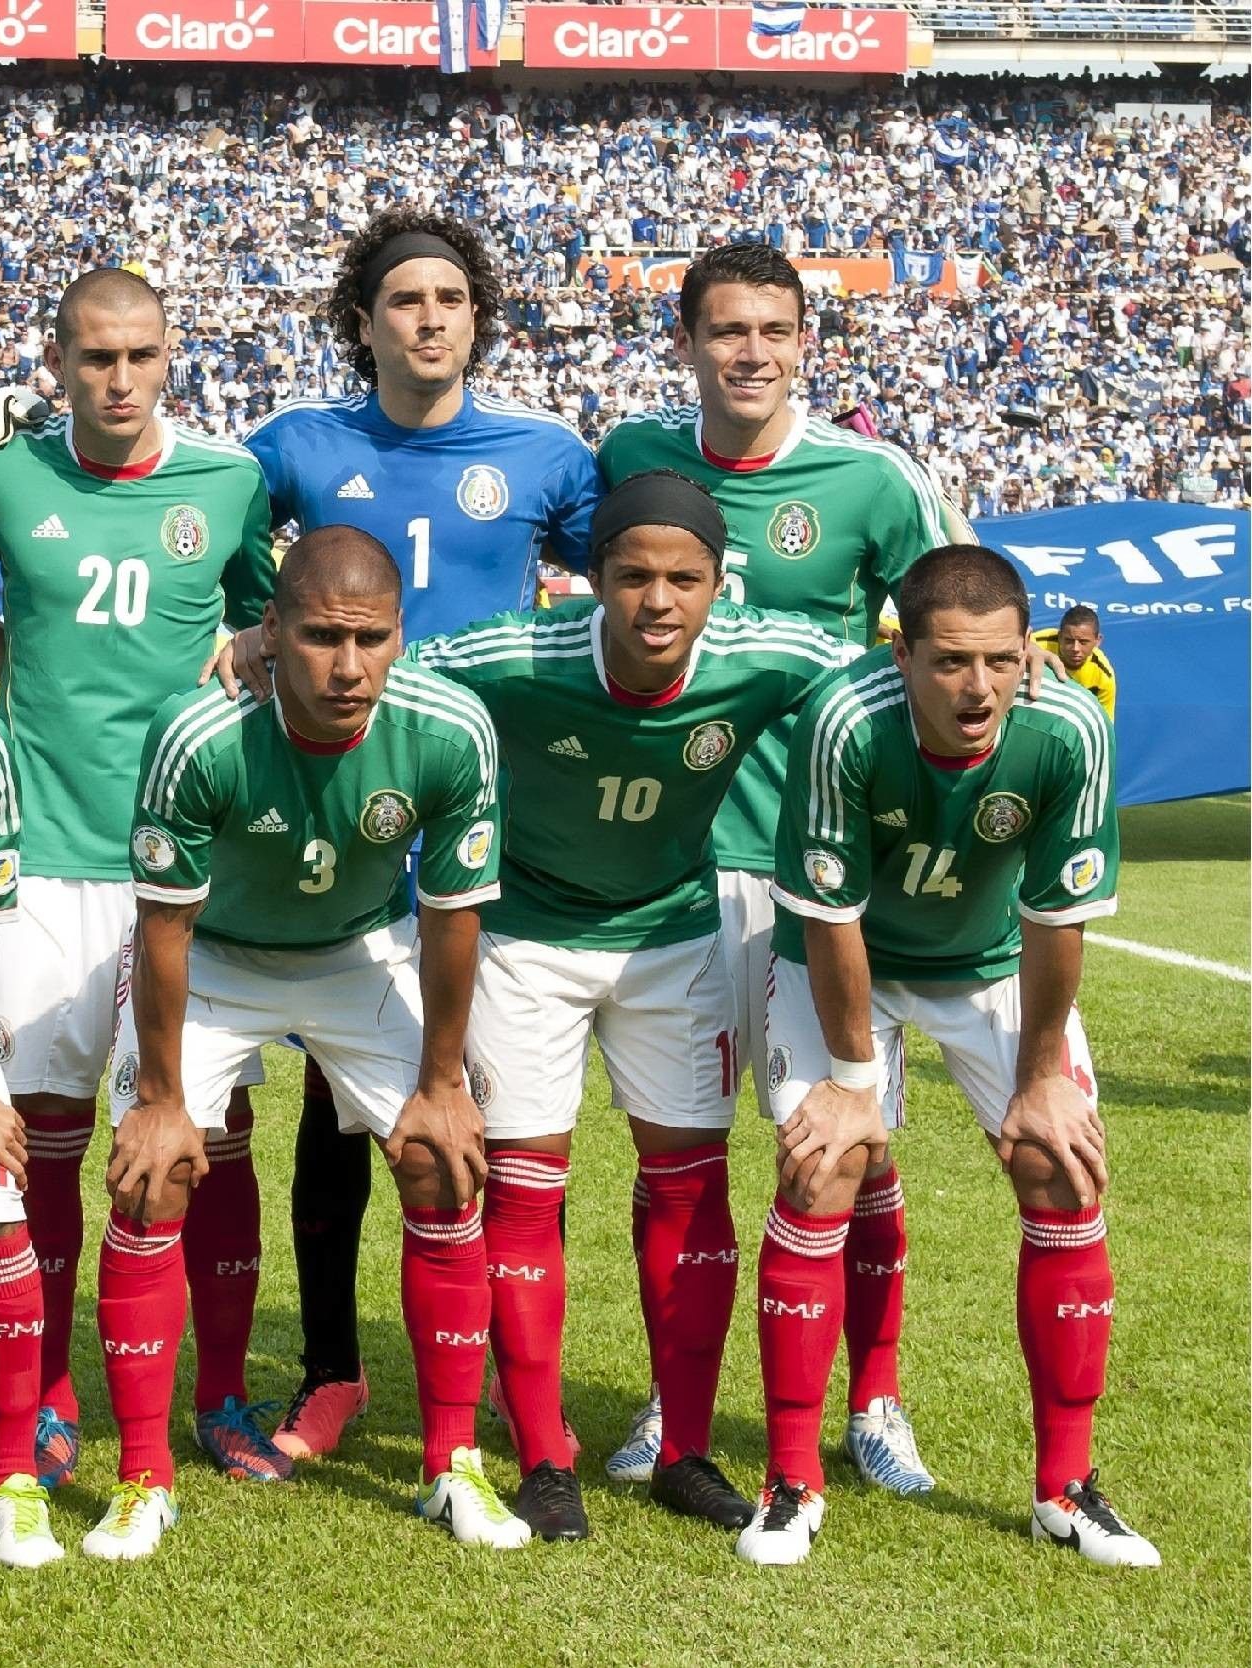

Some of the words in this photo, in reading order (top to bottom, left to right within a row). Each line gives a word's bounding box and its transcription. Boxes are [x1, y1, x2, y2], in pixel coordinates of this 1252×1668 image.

[136, 13, 253, 50] Claro
[554, 21, 667, 58] Claro
[407, 517, 431, 589] 1
[714, 549, 749, 605] 5
[76, 554, 150, 627] 20
[597, 775, 663, 823] 10
[247, 823, 290, 833] adidas
[298, 839, 337, 894] 3
[901, 843, 963, 899] 14
